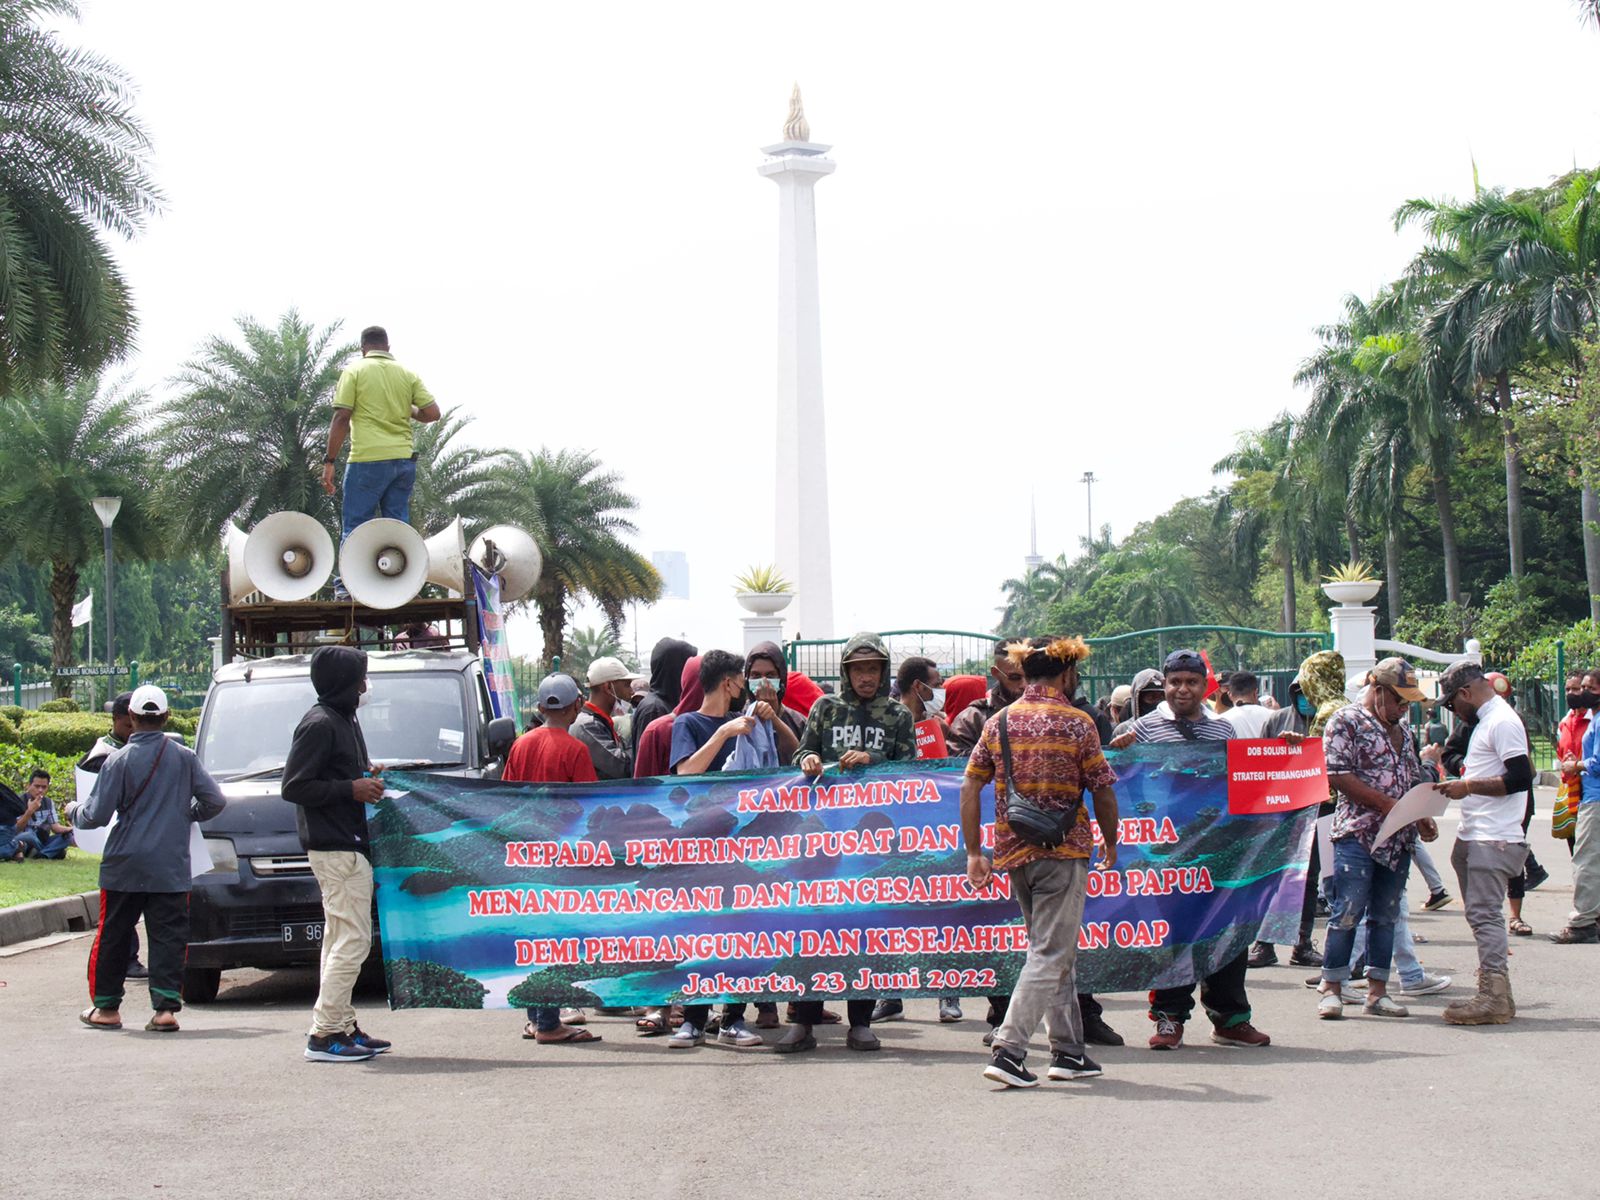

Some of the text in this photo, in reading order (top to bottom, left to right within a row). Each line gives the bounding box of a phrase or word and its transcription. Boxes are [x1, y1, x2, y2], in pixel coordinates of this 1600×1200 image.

[81, 667, 98, 675] MONAS
[831, 725, 886, 750] PEACE
[1247, 747, 1262, 757] DOB
[1263, 746, 1287, 756] SOLUSI
[1232, 767, 1322, 782] STRATEGI PEMBANGUNAN
[737, 780, 941, 812] KAMI MEMINTA
[1265, 794, 1291, 806] PAPUA
[505, 840, 614, 867] KEPADA
[625, 835, 801, 866] PEMERINTAH
[805, 828, 894, 858] PUSAT
[898, 824, 960, 852] DAN
[468, 866, 1214, 916] MENANDATANGANI DAN MENGESAHKAN OB PAPUA
[284, 924, 322, 942] B 96
[515, 939, 580, 966] DEMI
[584, 930, 795, 964] PEMBANGUNAN
[799, 928, 862, 958] DAN
[1114, 920, 1170, 948] OAP
[681, 967, 997, 996] Jakarta, 23 Juni 2022
